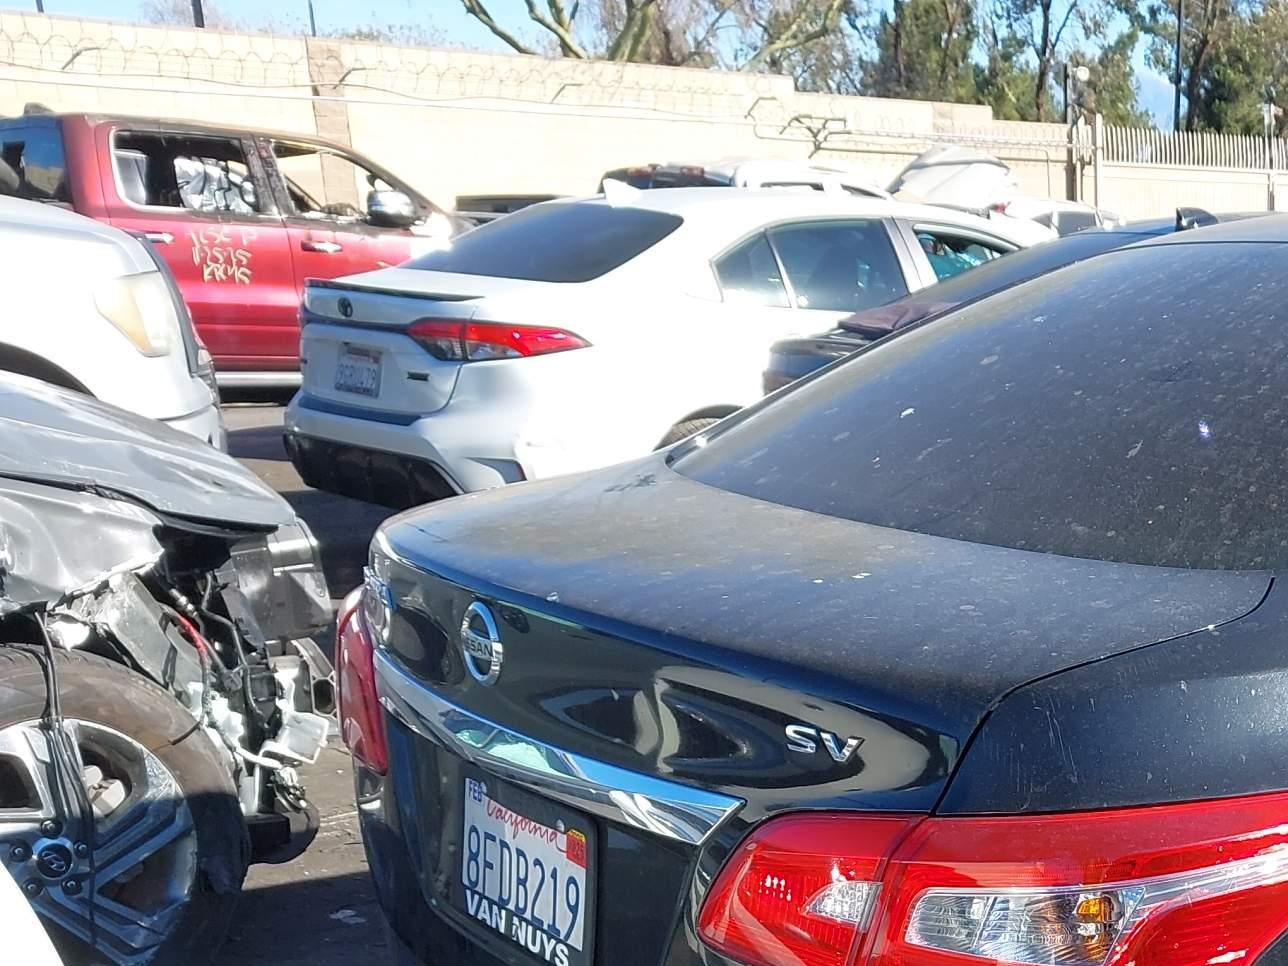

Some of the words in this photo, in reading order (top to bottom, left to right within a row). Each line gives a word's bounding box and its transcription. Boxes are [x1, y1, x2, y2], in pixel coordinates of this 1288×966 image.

[785, 724, 865, 762] SV
[469, 779, 483, 802] FEB
[467, 824, 580, 943] 8FDB219
[465, 888, 506, 934] VAN
